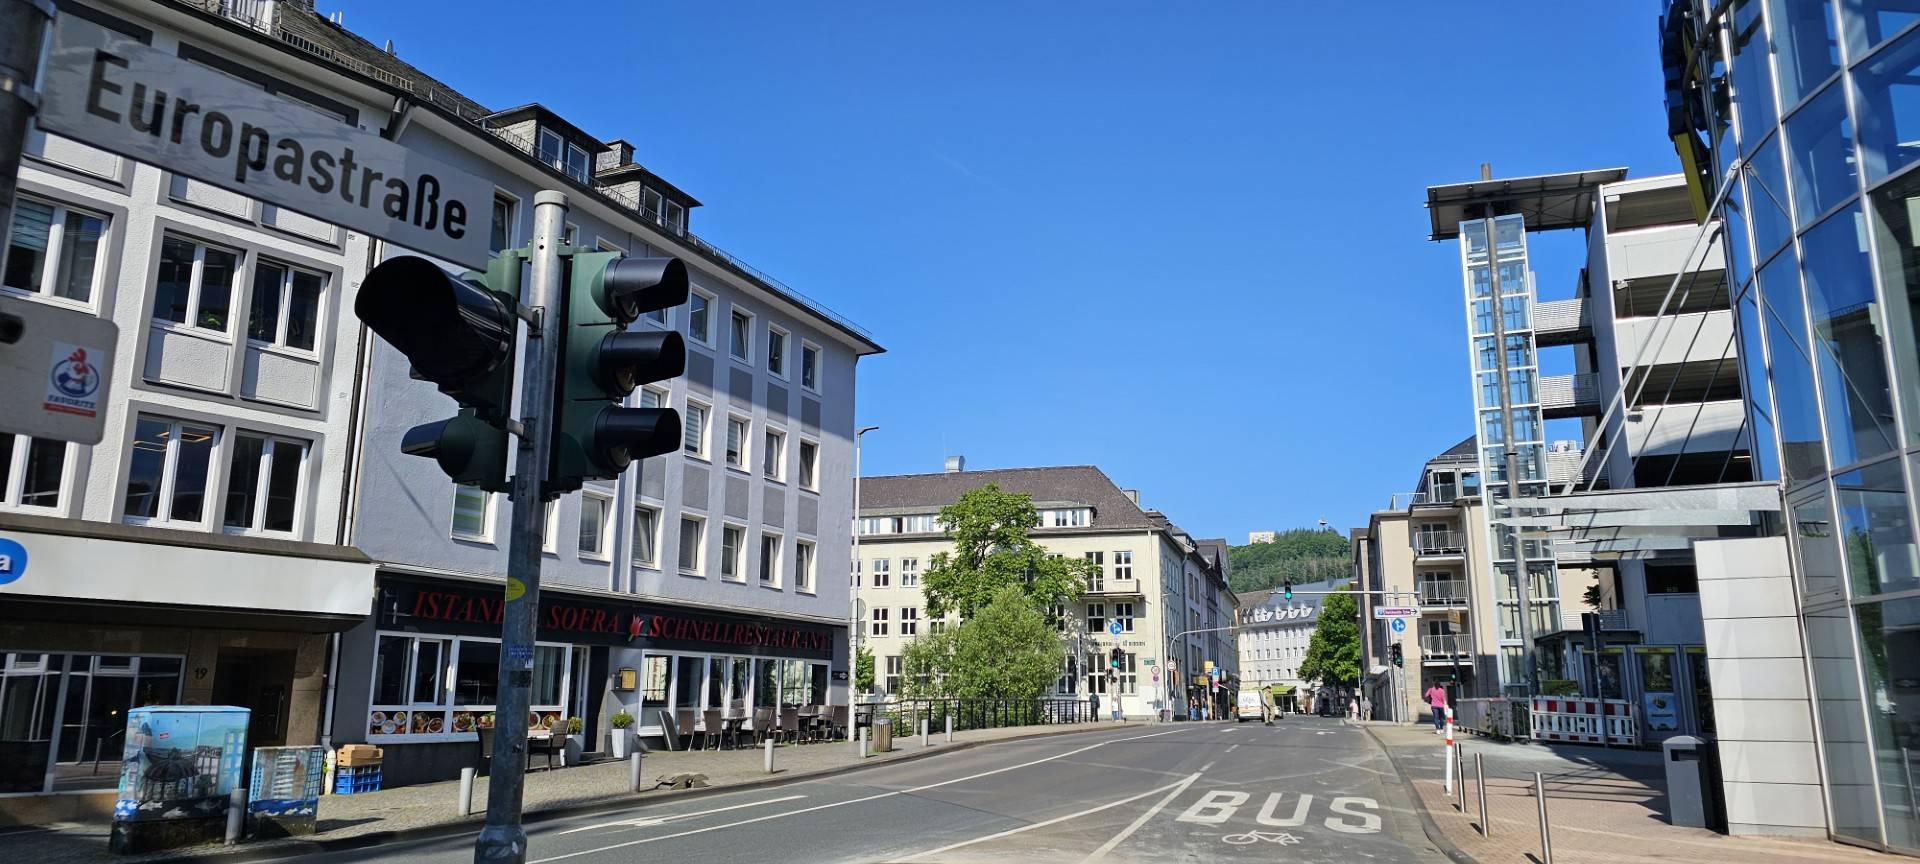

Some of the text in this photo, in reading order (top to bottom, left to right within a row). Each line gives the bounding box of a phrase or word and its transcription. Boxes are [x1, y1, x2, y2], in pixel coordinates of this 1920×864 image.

[86, 48, 467, 240] Europastraße
[412, 590, 828, 650] ISTAN SOFRA SCHNELLRESTAURANT
[195, 667, 208, 680] 19
[1175, 790, 1382, 834] BUS
